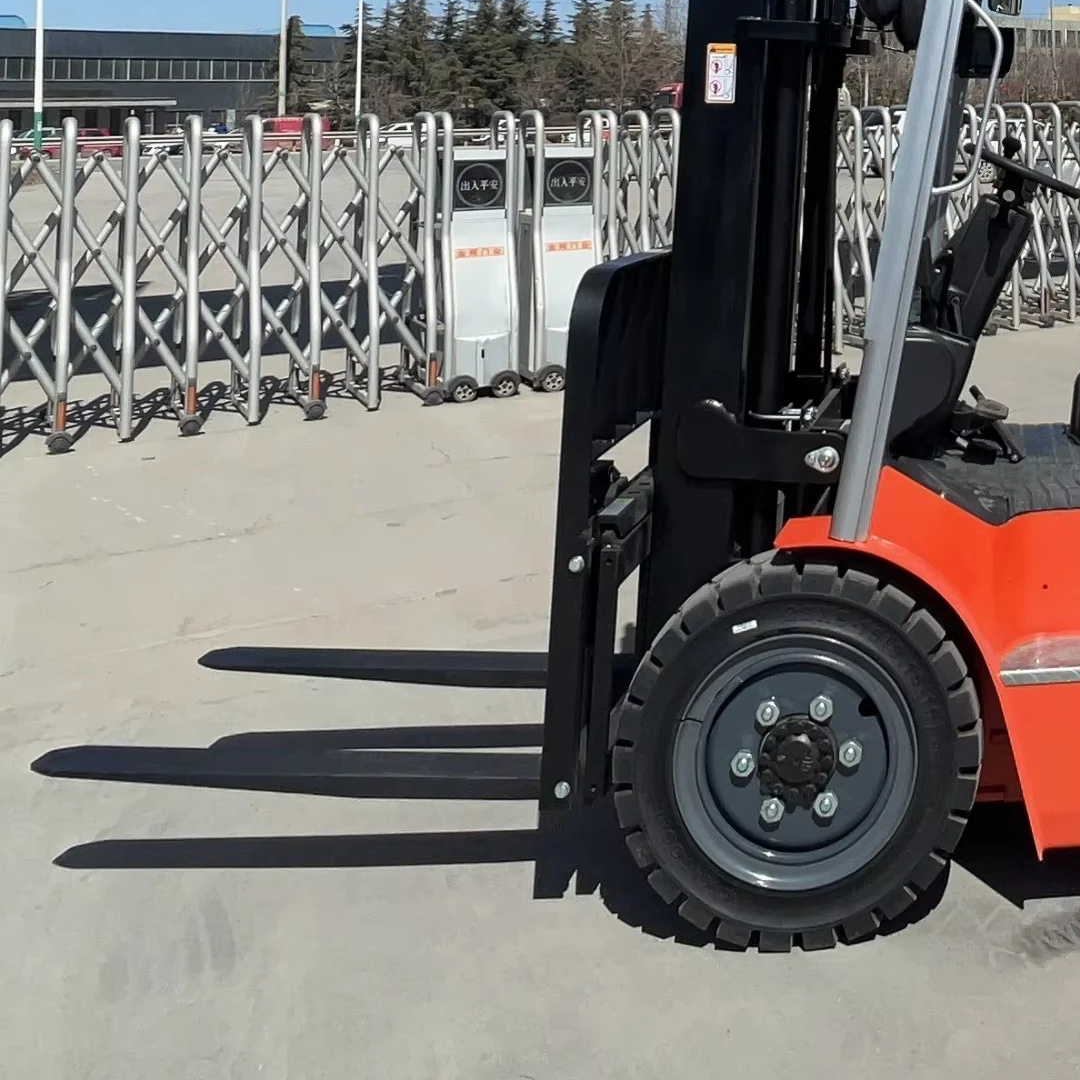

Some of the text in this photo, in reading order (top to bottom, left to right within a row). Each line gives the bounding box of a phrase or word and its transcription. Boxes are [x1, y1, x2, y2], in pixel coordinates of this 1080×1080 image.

[460, 179, 499, 191] 出入平安
[550, 176, 586, 188] 出入平安
